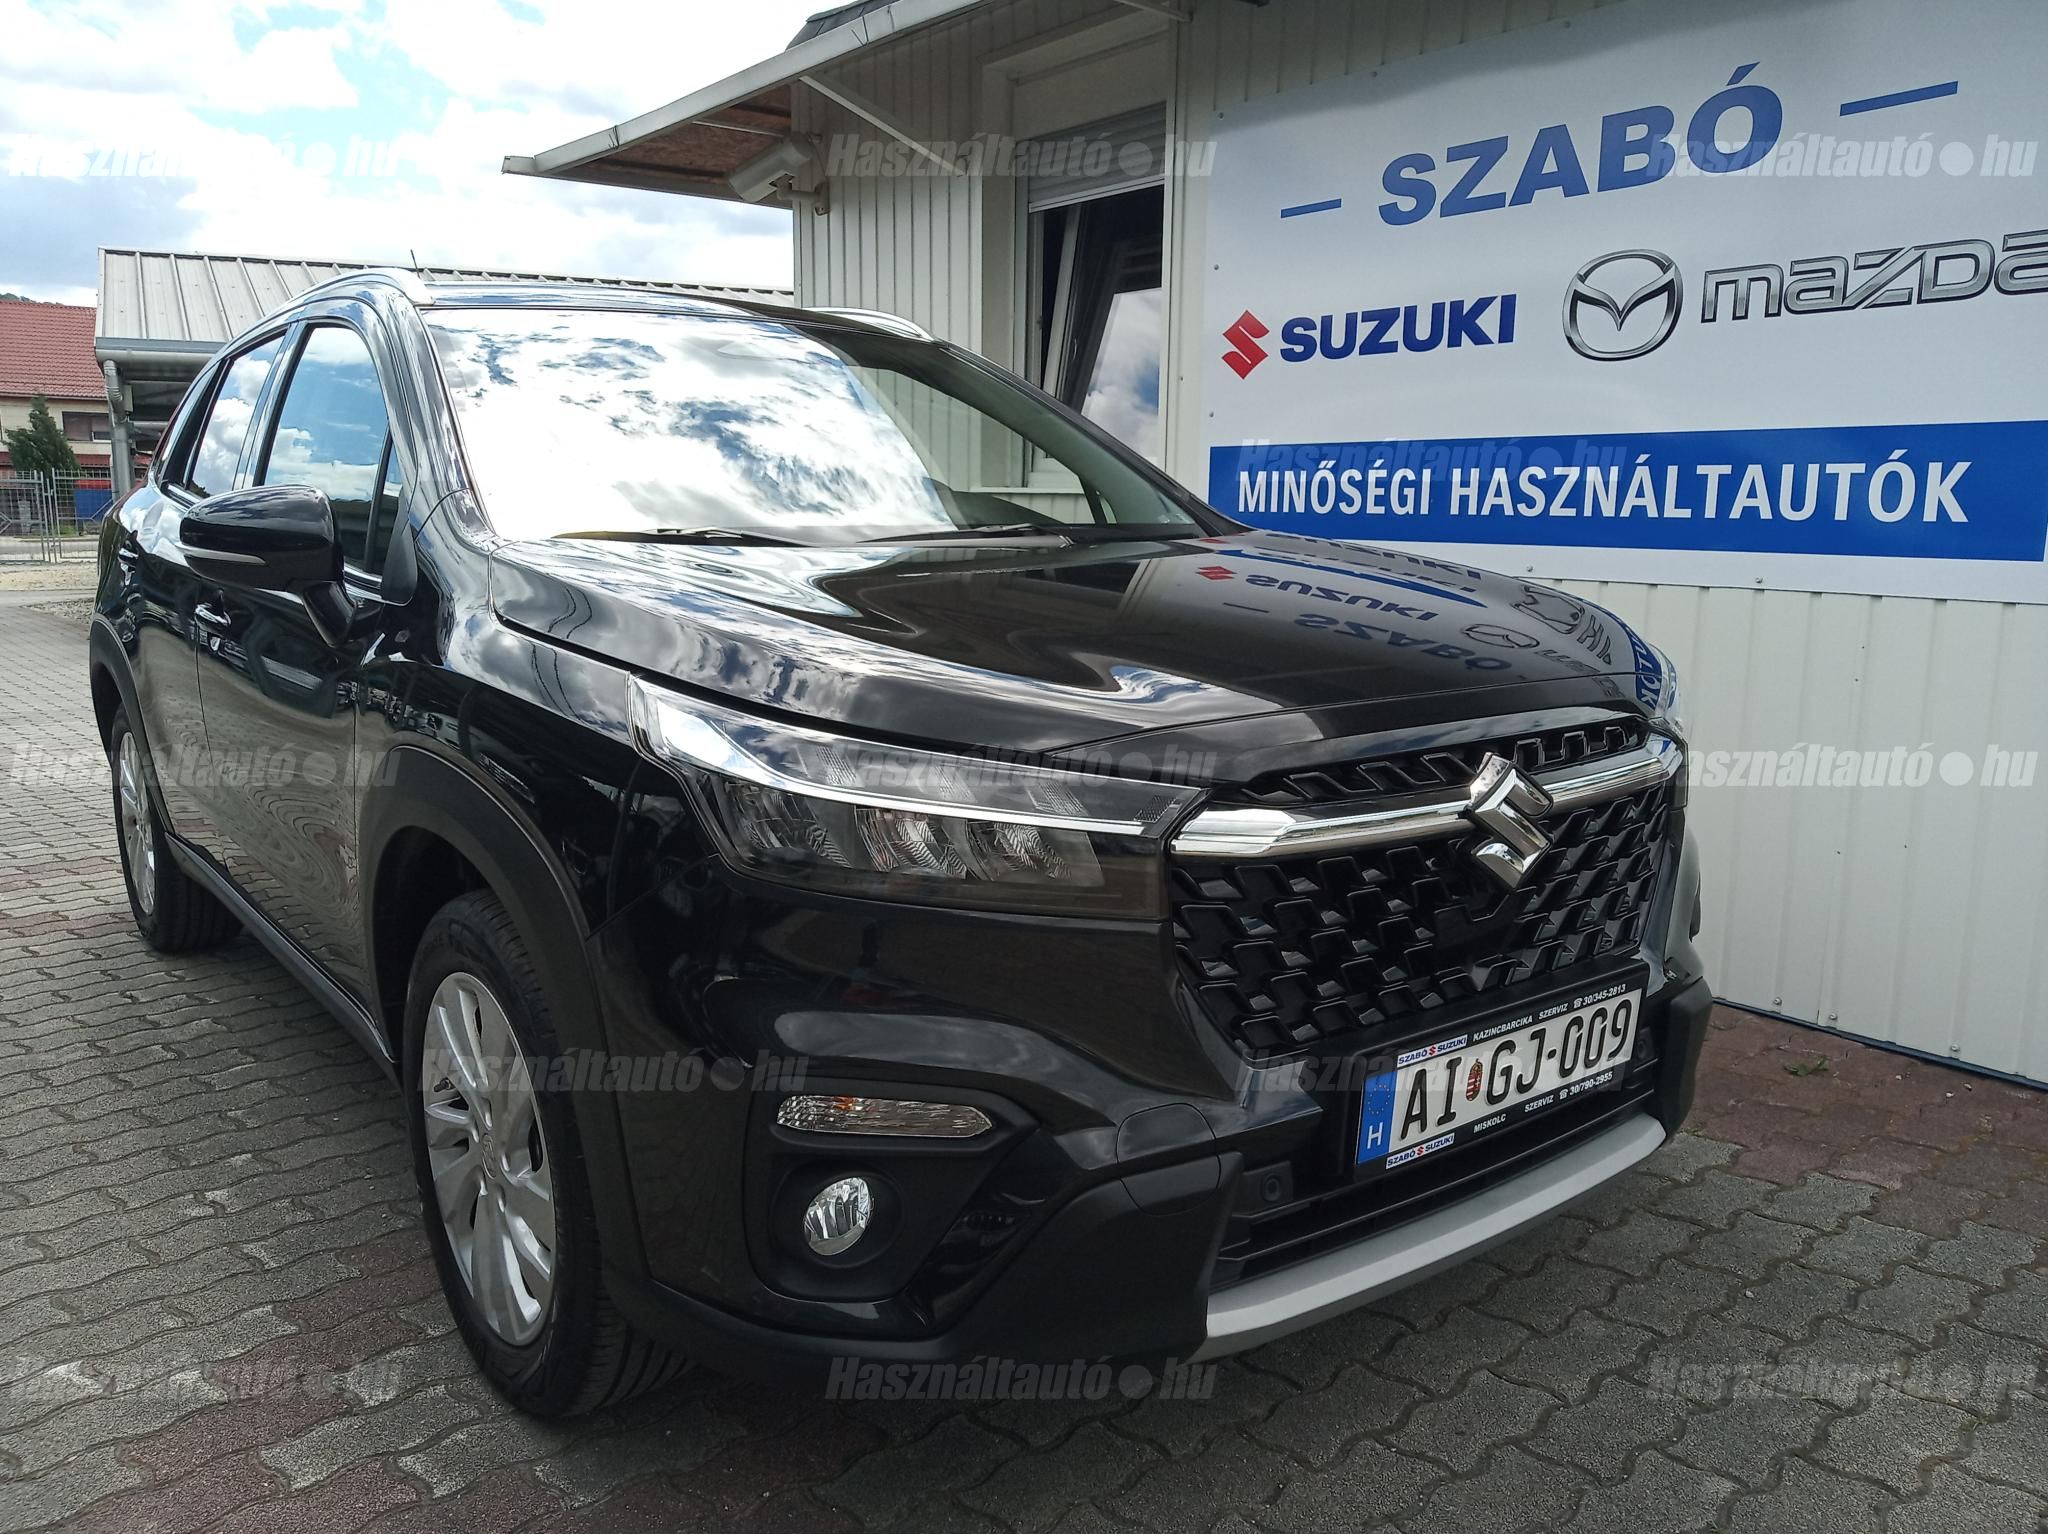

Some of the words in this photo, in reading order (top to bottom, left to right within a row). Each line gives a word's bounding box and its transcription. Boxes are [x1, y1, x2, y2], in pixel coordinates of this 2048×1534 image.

[1377, 62, 1783, 227] SZABÓ
[1279, 293, 1518, 363] SUZUKI
[1237, 459, 1432, 516] MINŐSÉGI
[1449, 449, 1970, 524] HASZNÁLTAUTÓK
[1398, 1049, 1428, 1065] SZABÓ
[1437, 1038, 1467, 1053] SUZUKI
[1472, 1015, 1533, 1042] KAZINCBARCIKA
[1538, 1003, 1569, 1020] SZERVIZ
[1366, 1121, 1384, 1150] H
[1387, 1149, 1416, 1167] SZABÓ
[1425, 1135, 1455, 1152] SUZUKI
[1473, 1114, 1507, 1133] MISKOLC
[1524, 1095, 1555, 1113] SZERVIZ
